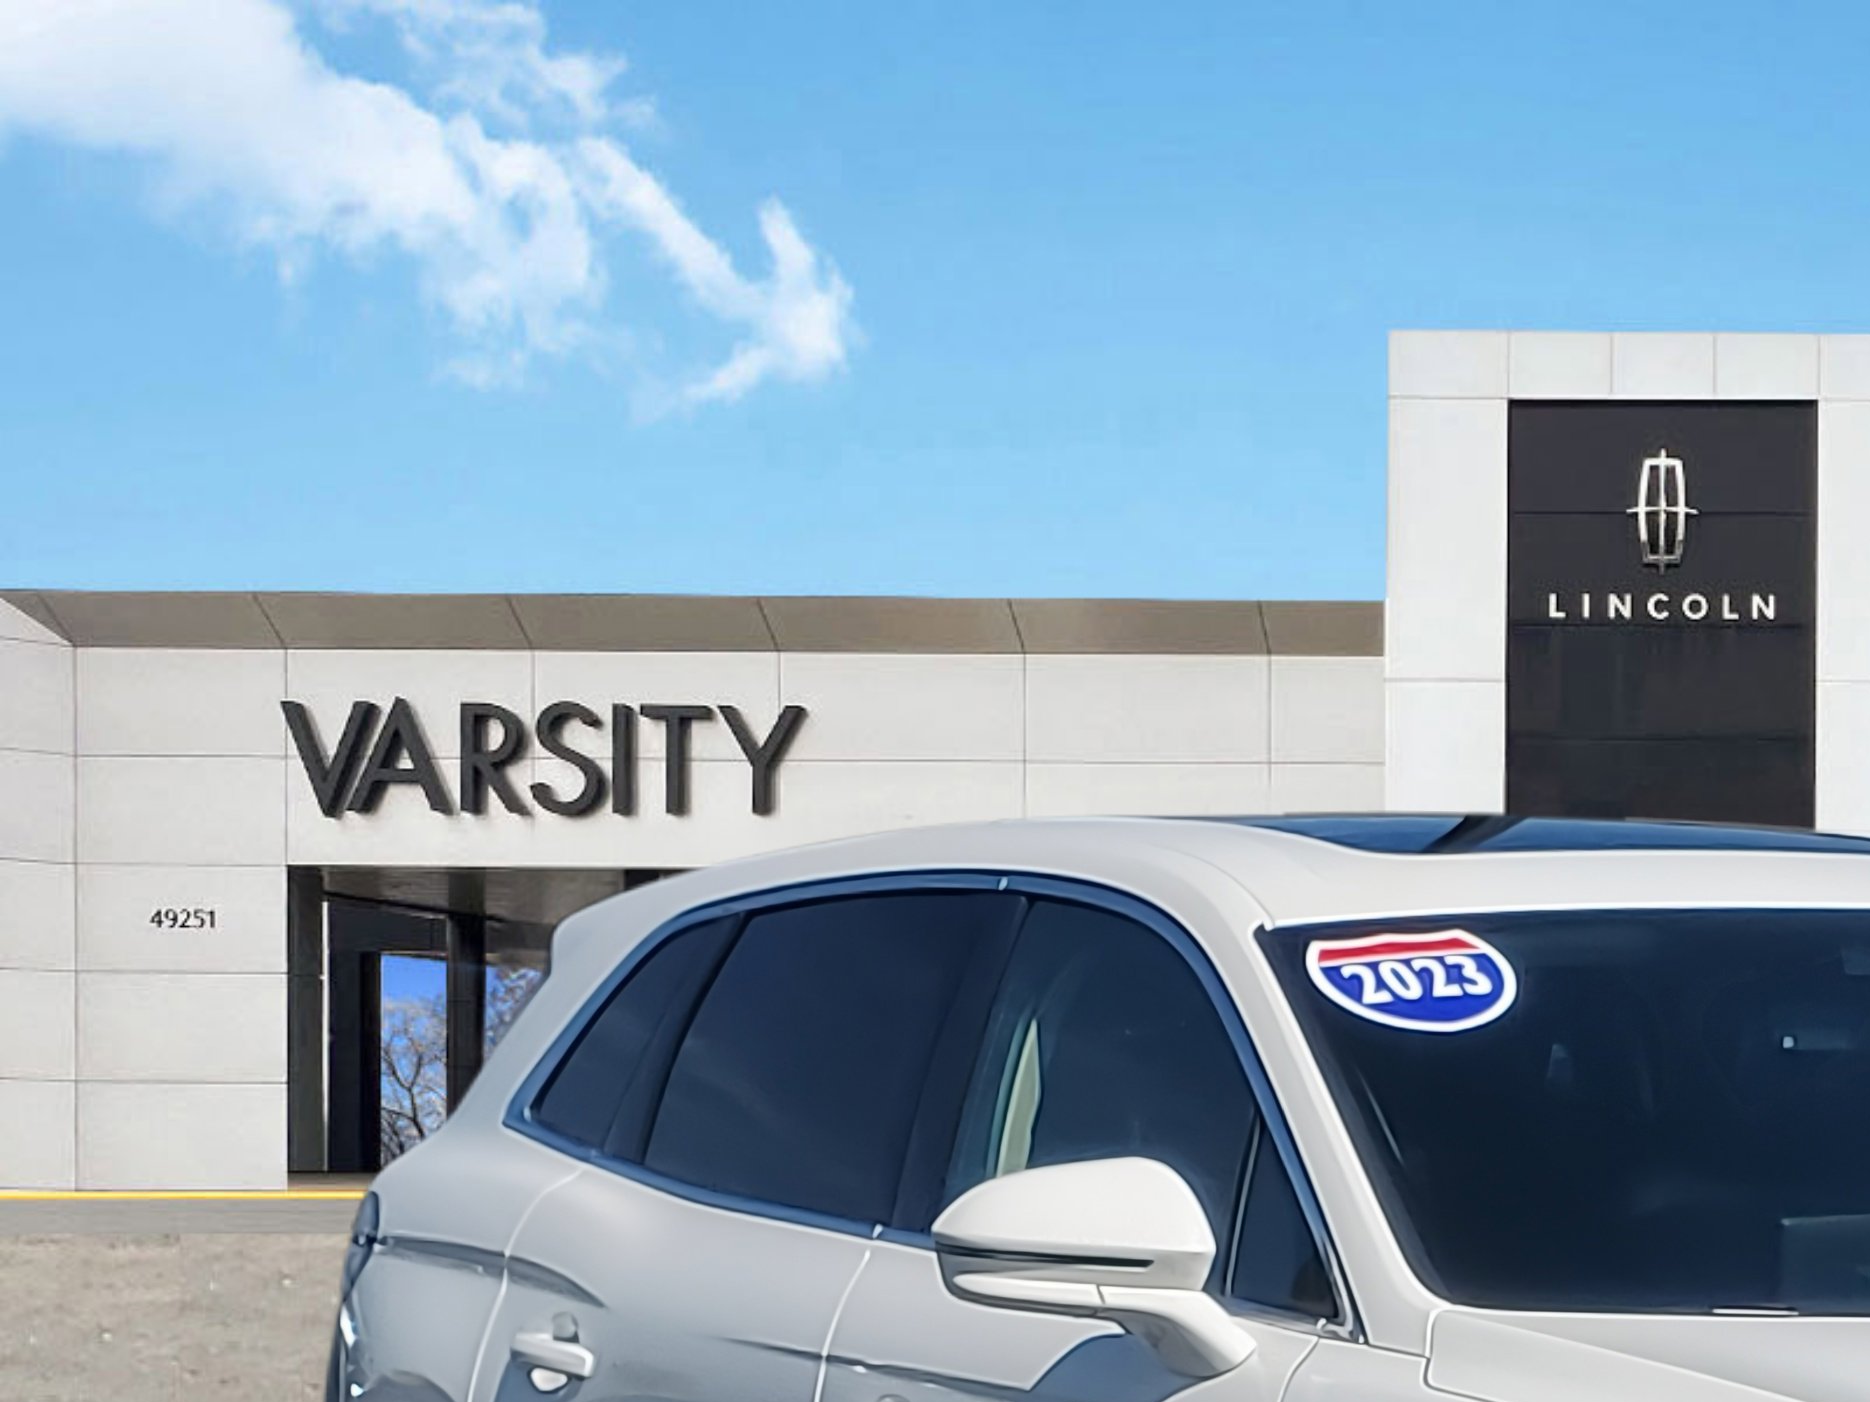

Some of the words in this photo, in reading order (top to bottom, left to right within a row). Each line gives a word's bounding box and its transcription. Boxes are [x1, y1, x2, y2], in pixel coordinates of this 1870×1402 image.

[1548, 592, 1776, 620] LINCOLN
[280, 696, 807, 818] VARSITY
[149, 908, 216, 928] 49251
[1340, 955, 1493, 1004] 2023
